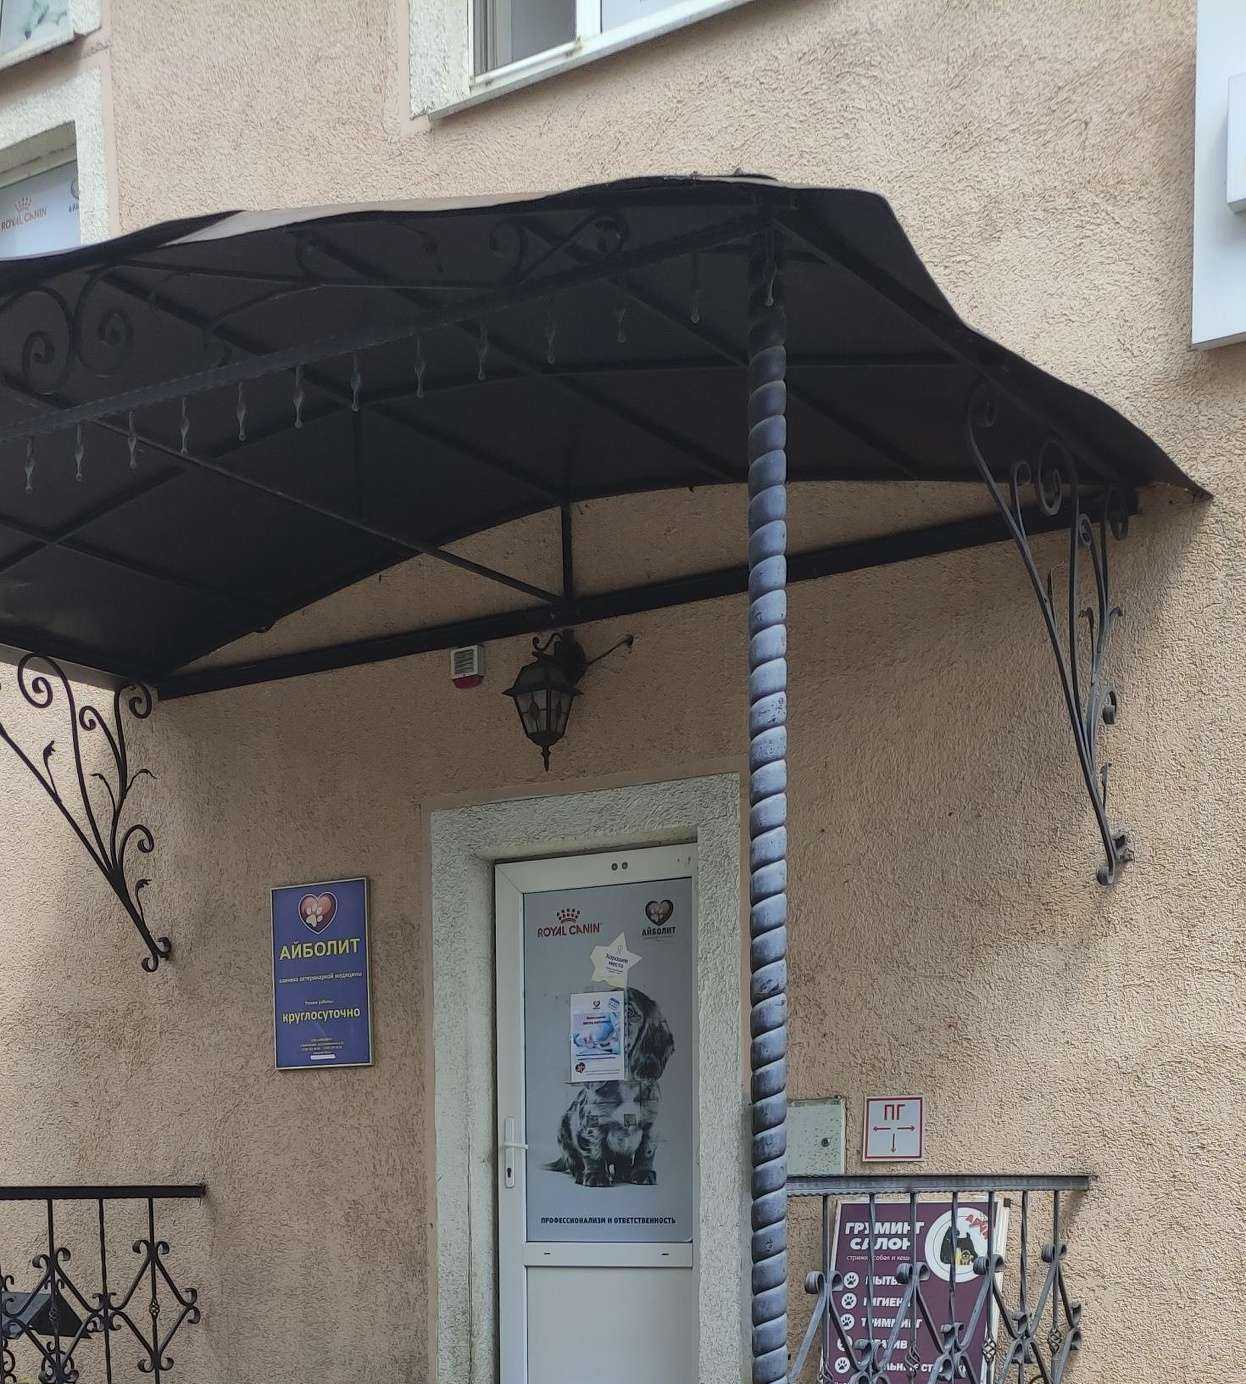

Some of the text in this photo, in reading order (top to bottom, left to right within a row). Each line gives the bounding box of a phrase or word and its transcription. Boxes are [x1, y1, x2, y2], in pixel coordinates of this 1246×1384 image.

[537, 923, 600, 938] ROYAL CANIN
[641, 926, 676, 937] АЙБОЛИТ
[279, 938, 360, 960] АЙБОЛИТ
[282, 1008, 361, 1025] круглосуточно
[884, 1104, 906, 1121] ПГ
[540, 1216, 606, 1225] ПРОФЕССИОНАЛИЗМ
[613, 1216, 676, 1225] ОТВЕТСТВЕННОСТЬ
